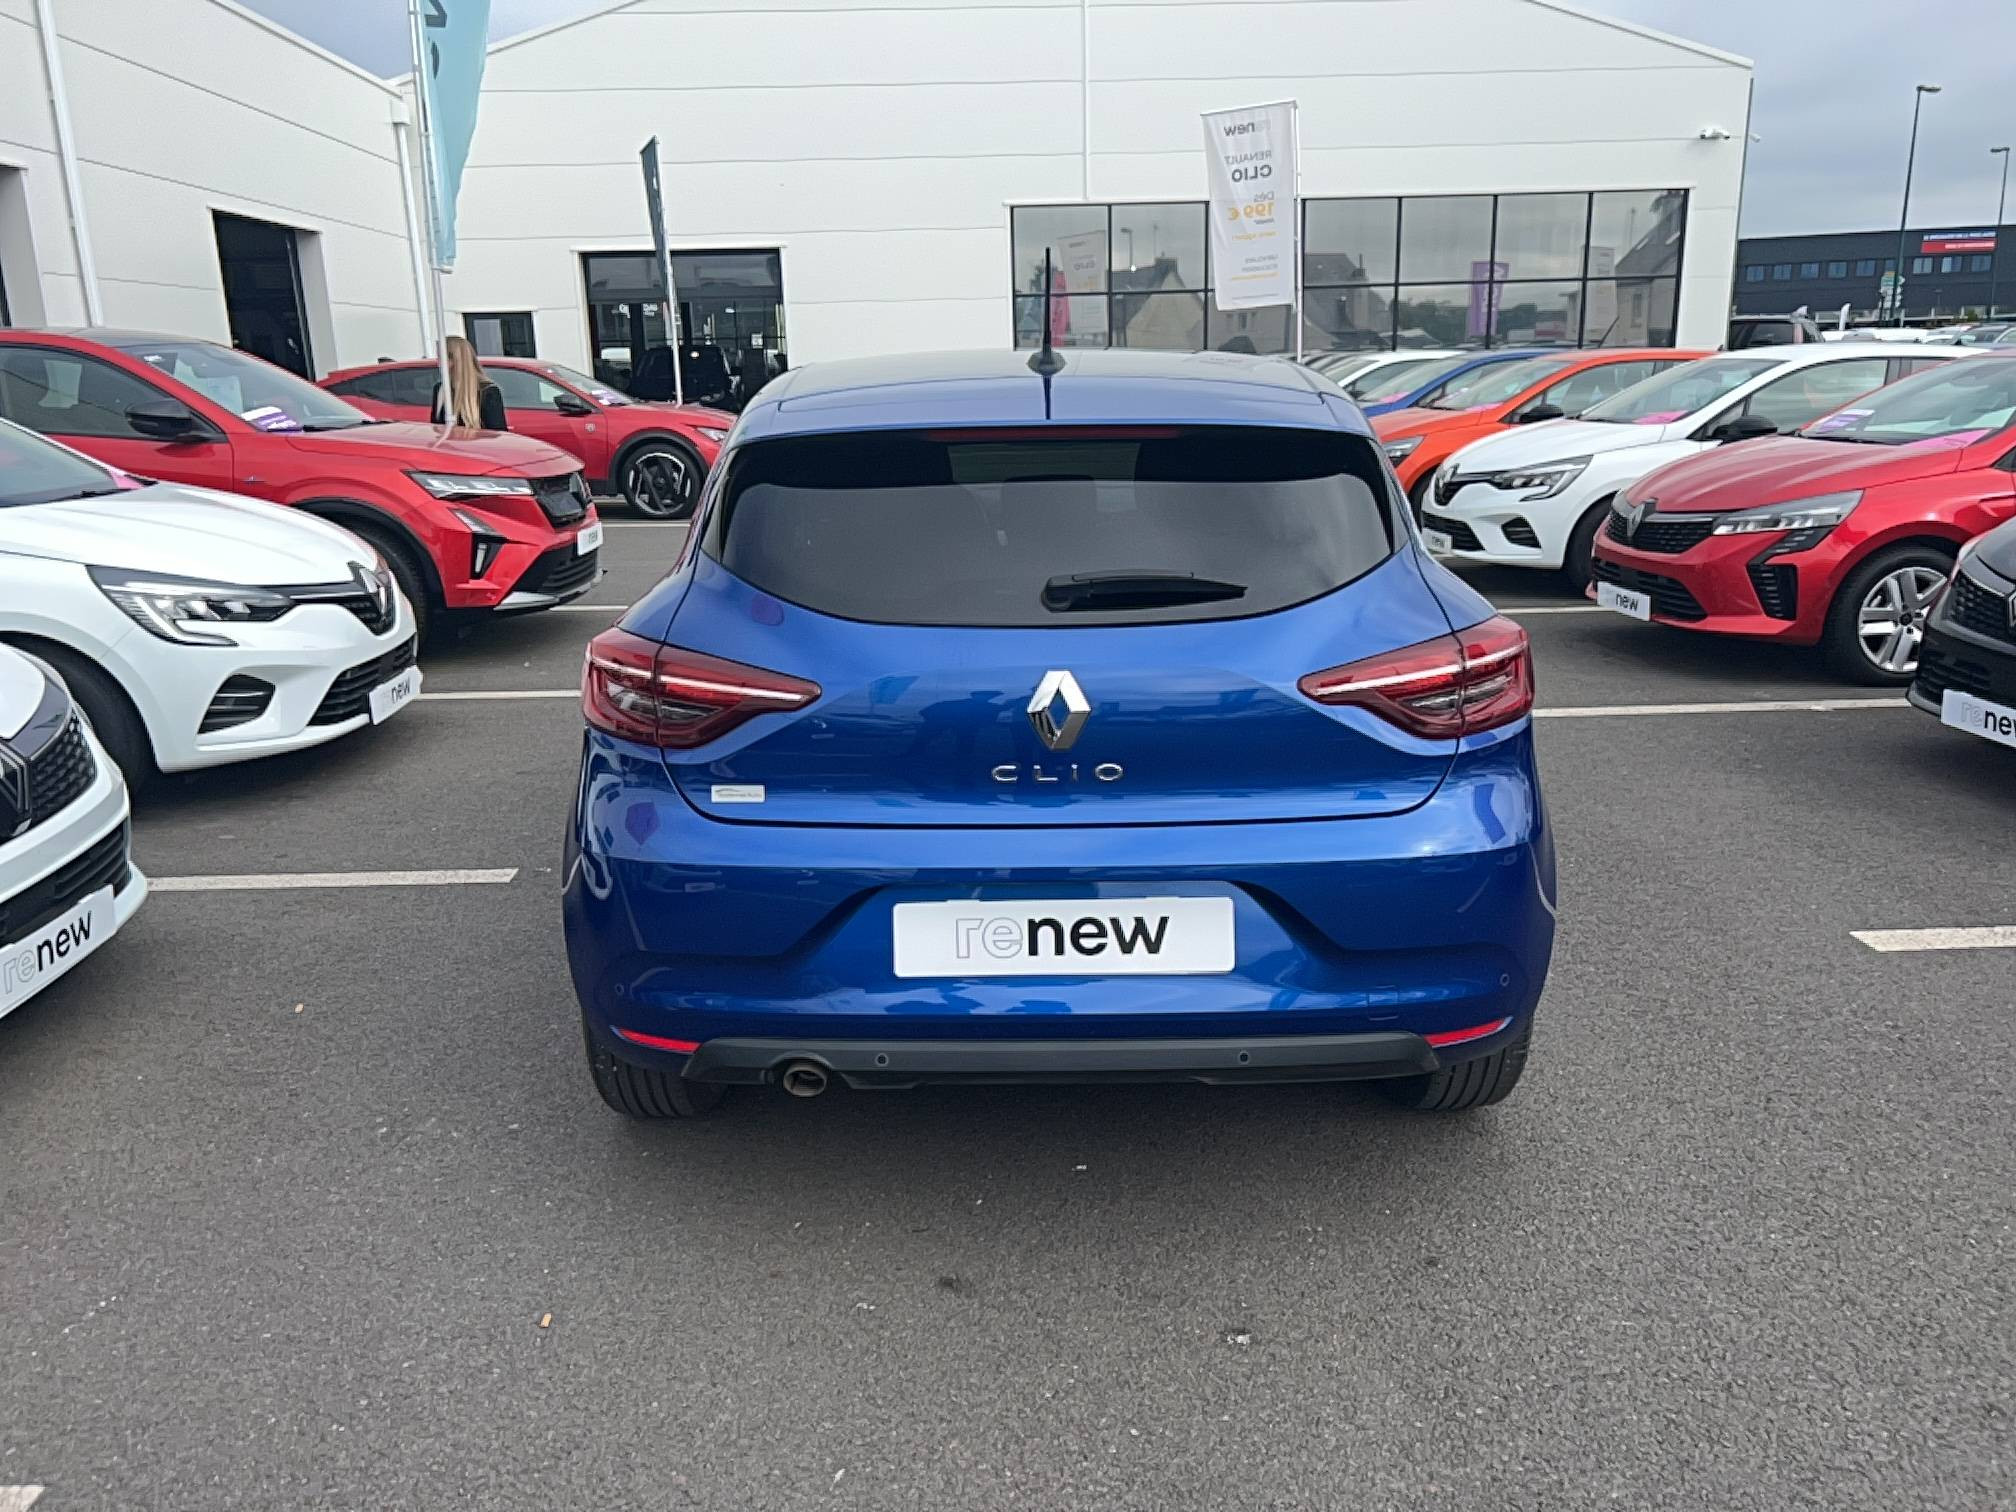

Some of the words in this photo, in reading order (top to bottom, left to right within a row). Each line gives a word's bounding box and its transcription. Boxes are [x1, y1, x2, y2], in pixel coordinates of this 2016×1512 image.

[1961, 702, 2016, 738] rene
[992, 763, 1124, 782] CLIO
[3, 910, 92, 995] renew
[955, 916, 1170, 959] renew
